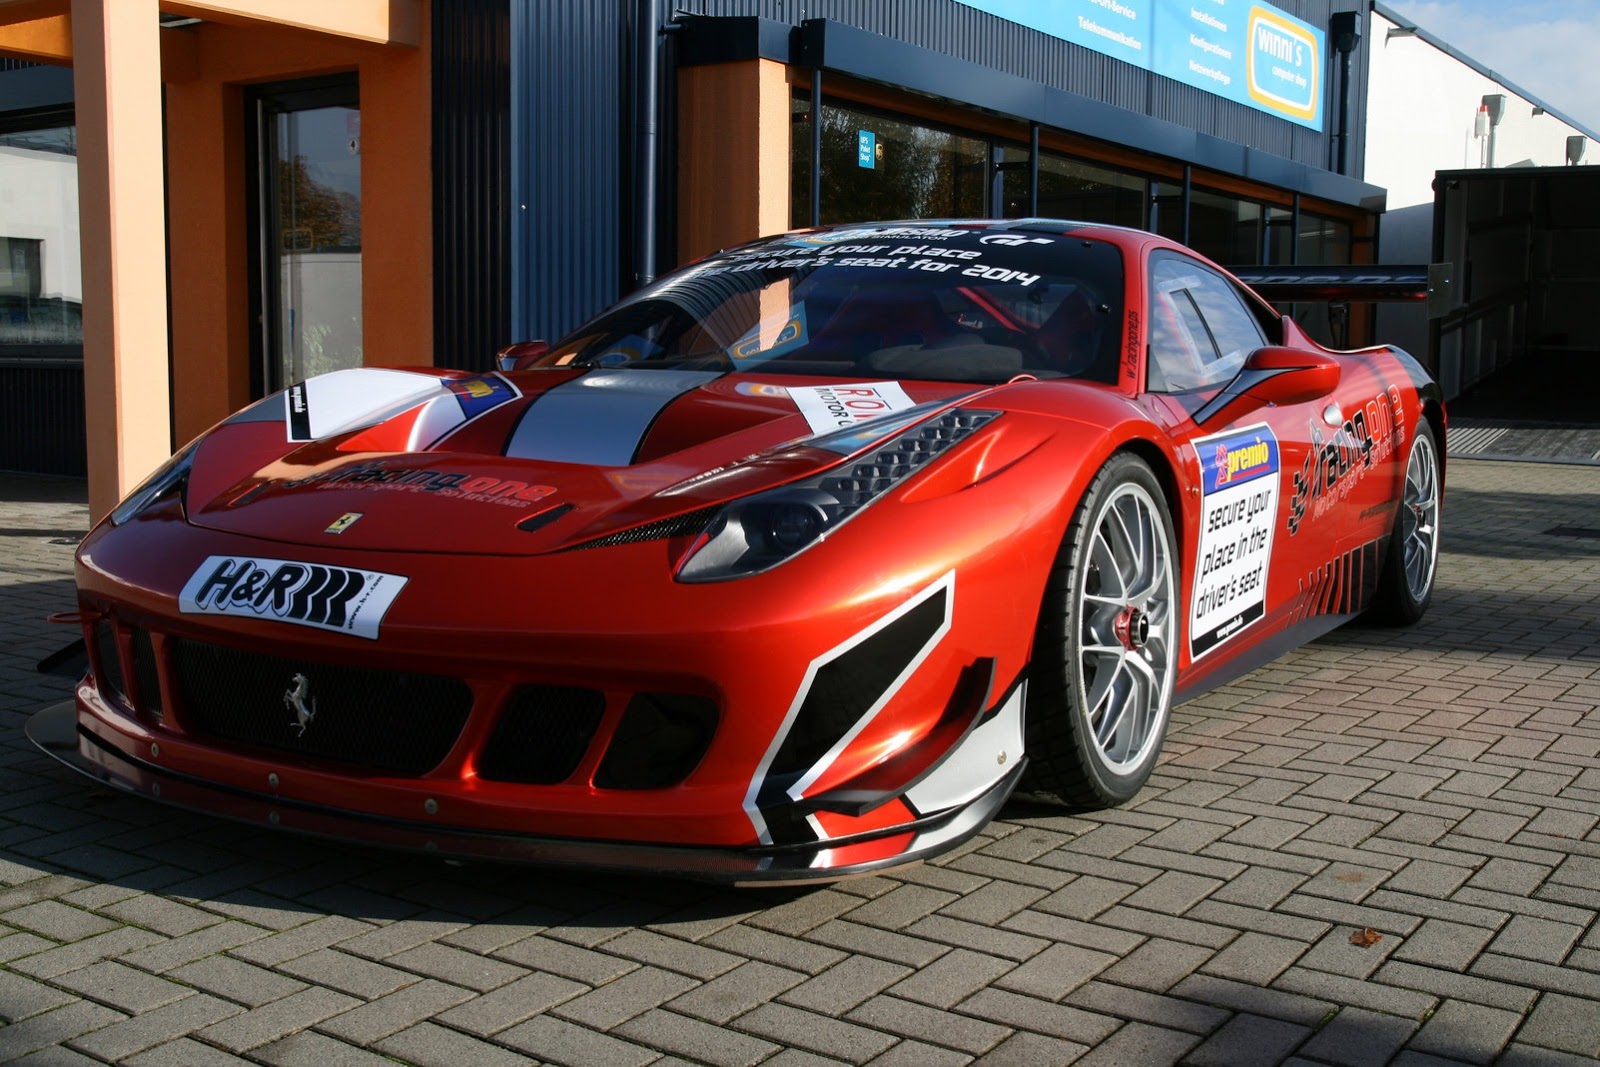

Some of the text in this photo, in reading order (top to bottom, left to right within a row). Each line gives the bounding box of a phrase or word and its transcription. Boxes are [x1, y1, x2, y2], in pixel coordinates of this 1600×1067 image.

[732, 256, 834, 273] driver's
[833, 256, 906, 268] seat
[907, 259, 960, 273] for
[961, 264, 1041, 287] 2014
[817, 243, 891, 255] your
[889, 245, 983, 260] place
[814, 387, 850, 419] MOTOR
[1227, 436, 1269, 482] premio
[1208, 489, 1272, 533] secure your
[1200, 525, 1268, 584] place in the
[195, 559, 310, 617] H&R
[347, 575, 384, 630] www.h-r.com
[1196, 560, 1263, 619] driver's seat
